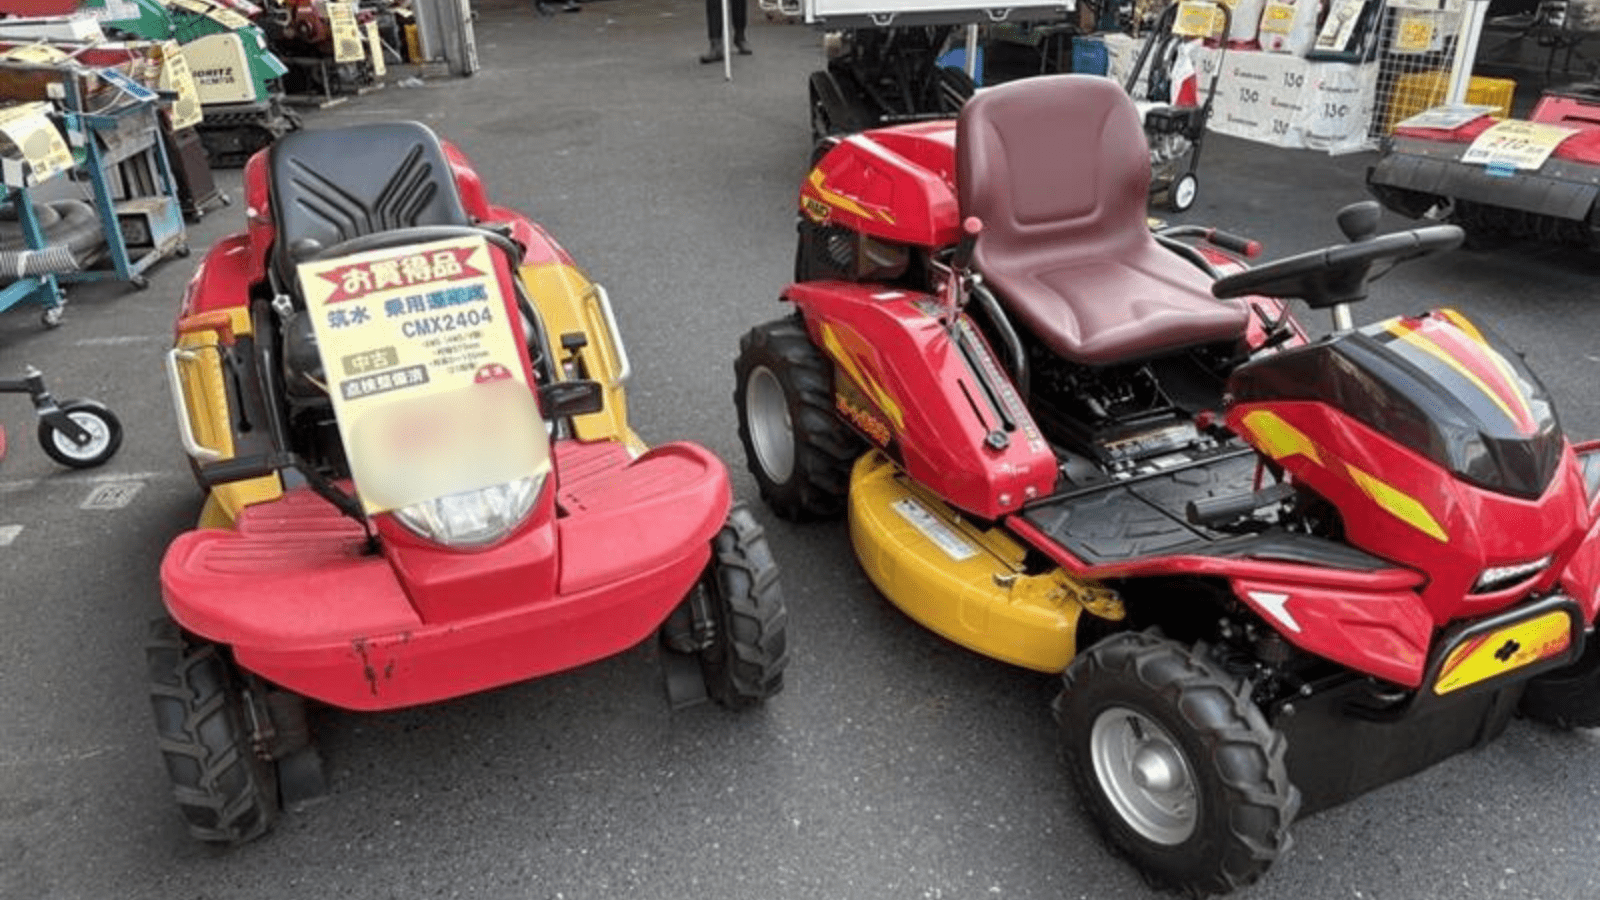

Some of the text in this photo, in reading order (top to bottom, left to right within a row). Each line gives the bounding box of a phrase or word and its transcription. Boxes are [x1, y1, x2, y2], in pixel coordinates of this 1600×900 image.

[190, 67, 232, 78] IORITZ
[341, 251, 464, 294] お買得品
[402, 306, 493, 338] CMX2404
